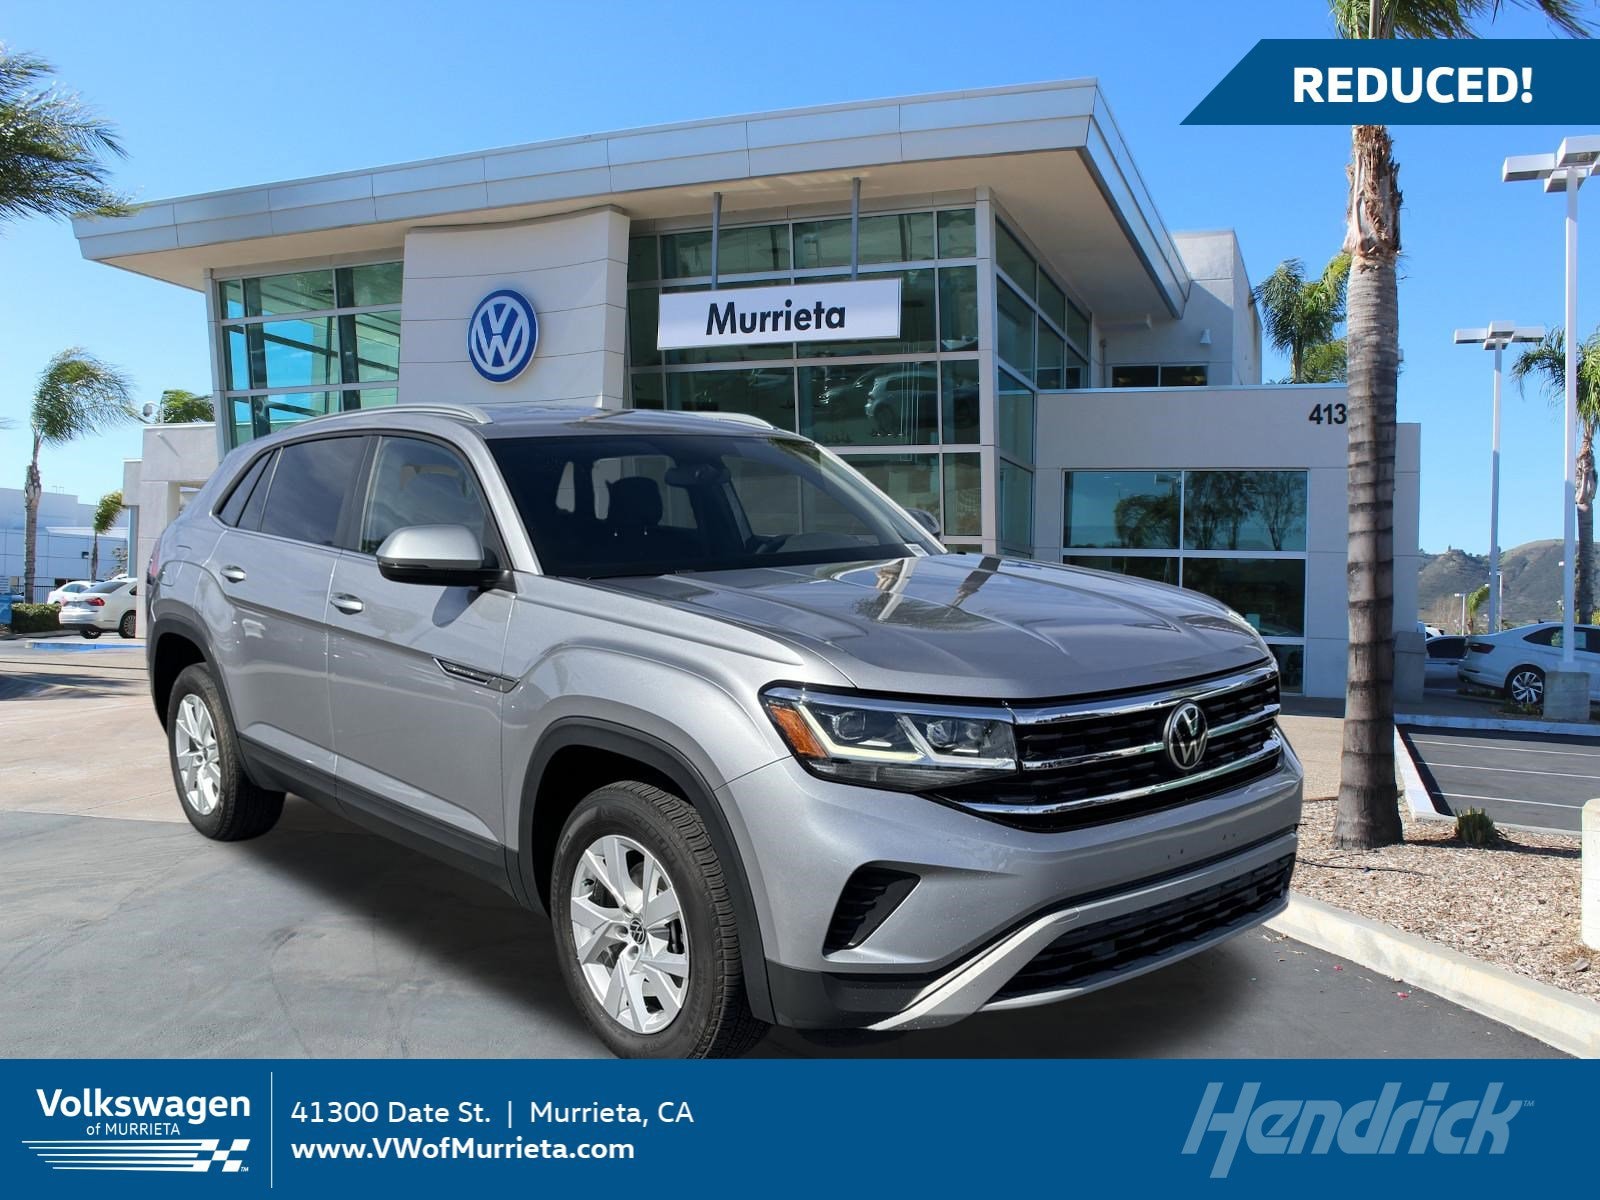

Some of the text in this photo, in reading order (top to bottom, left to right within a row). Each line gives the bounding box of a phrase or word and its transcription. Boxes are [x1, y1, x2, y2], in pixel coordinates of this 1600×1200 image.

[470, 294, 532, 376] VW
[705, 299, 846, 336] Murrieta
[1308, 403, 1347, 425] 413
